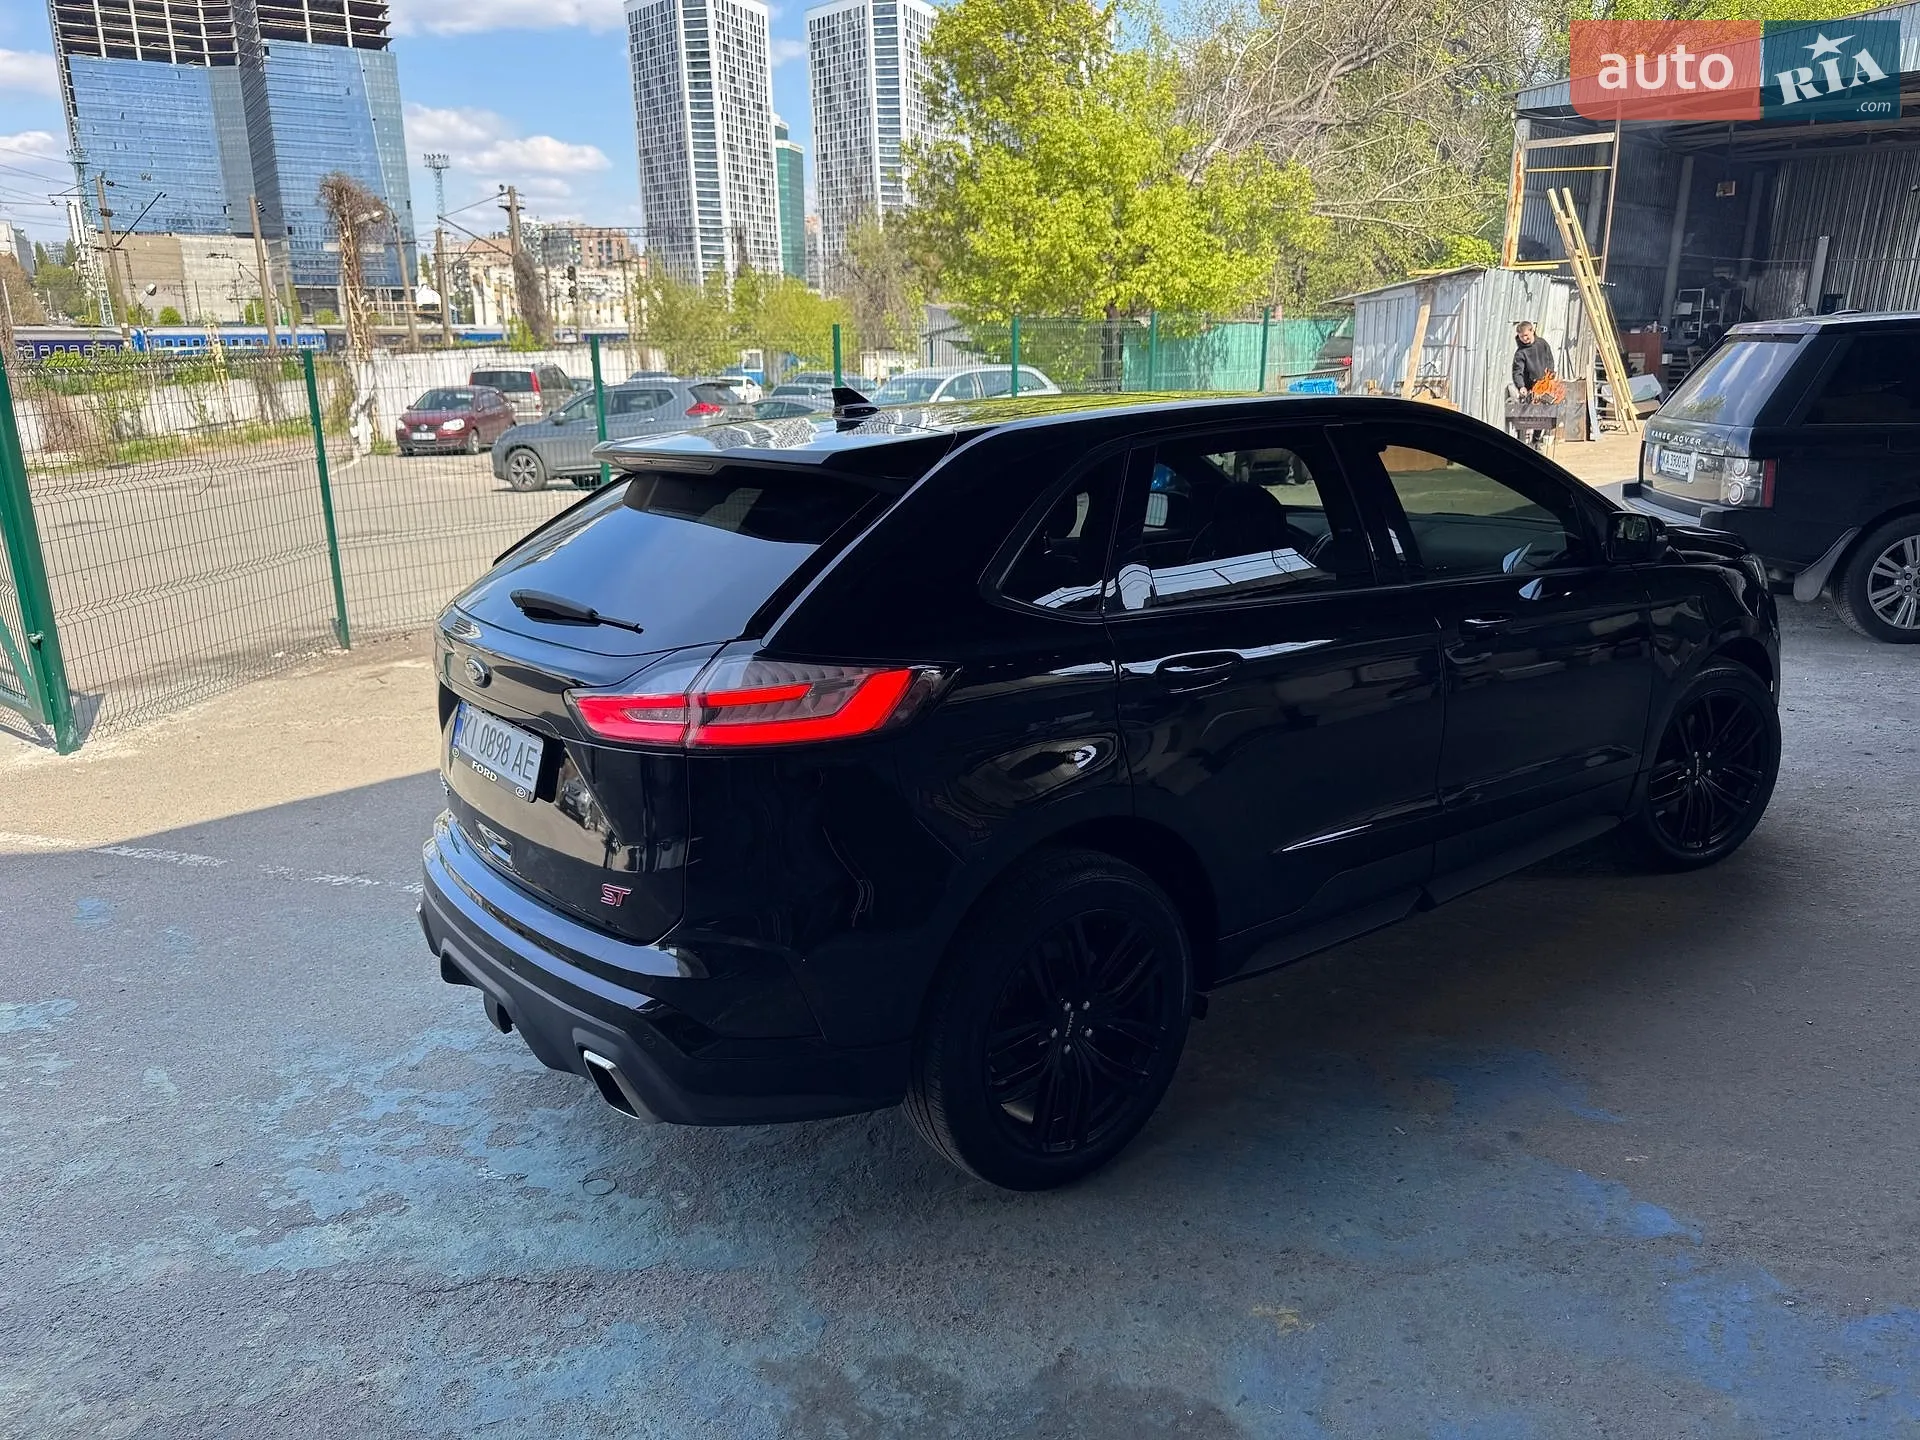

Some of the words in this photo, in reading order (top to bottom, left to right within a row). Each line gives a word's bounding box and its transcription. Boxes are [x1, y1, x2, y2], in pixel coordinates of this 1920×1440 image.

[1673, 434, 1702, 446] ROVER
[479, 723, 511, 766] 0898
[511, 741, 538, 781] AE
[471, 760, 498, 782] FORD
[600, 883, 632, 907] ST
